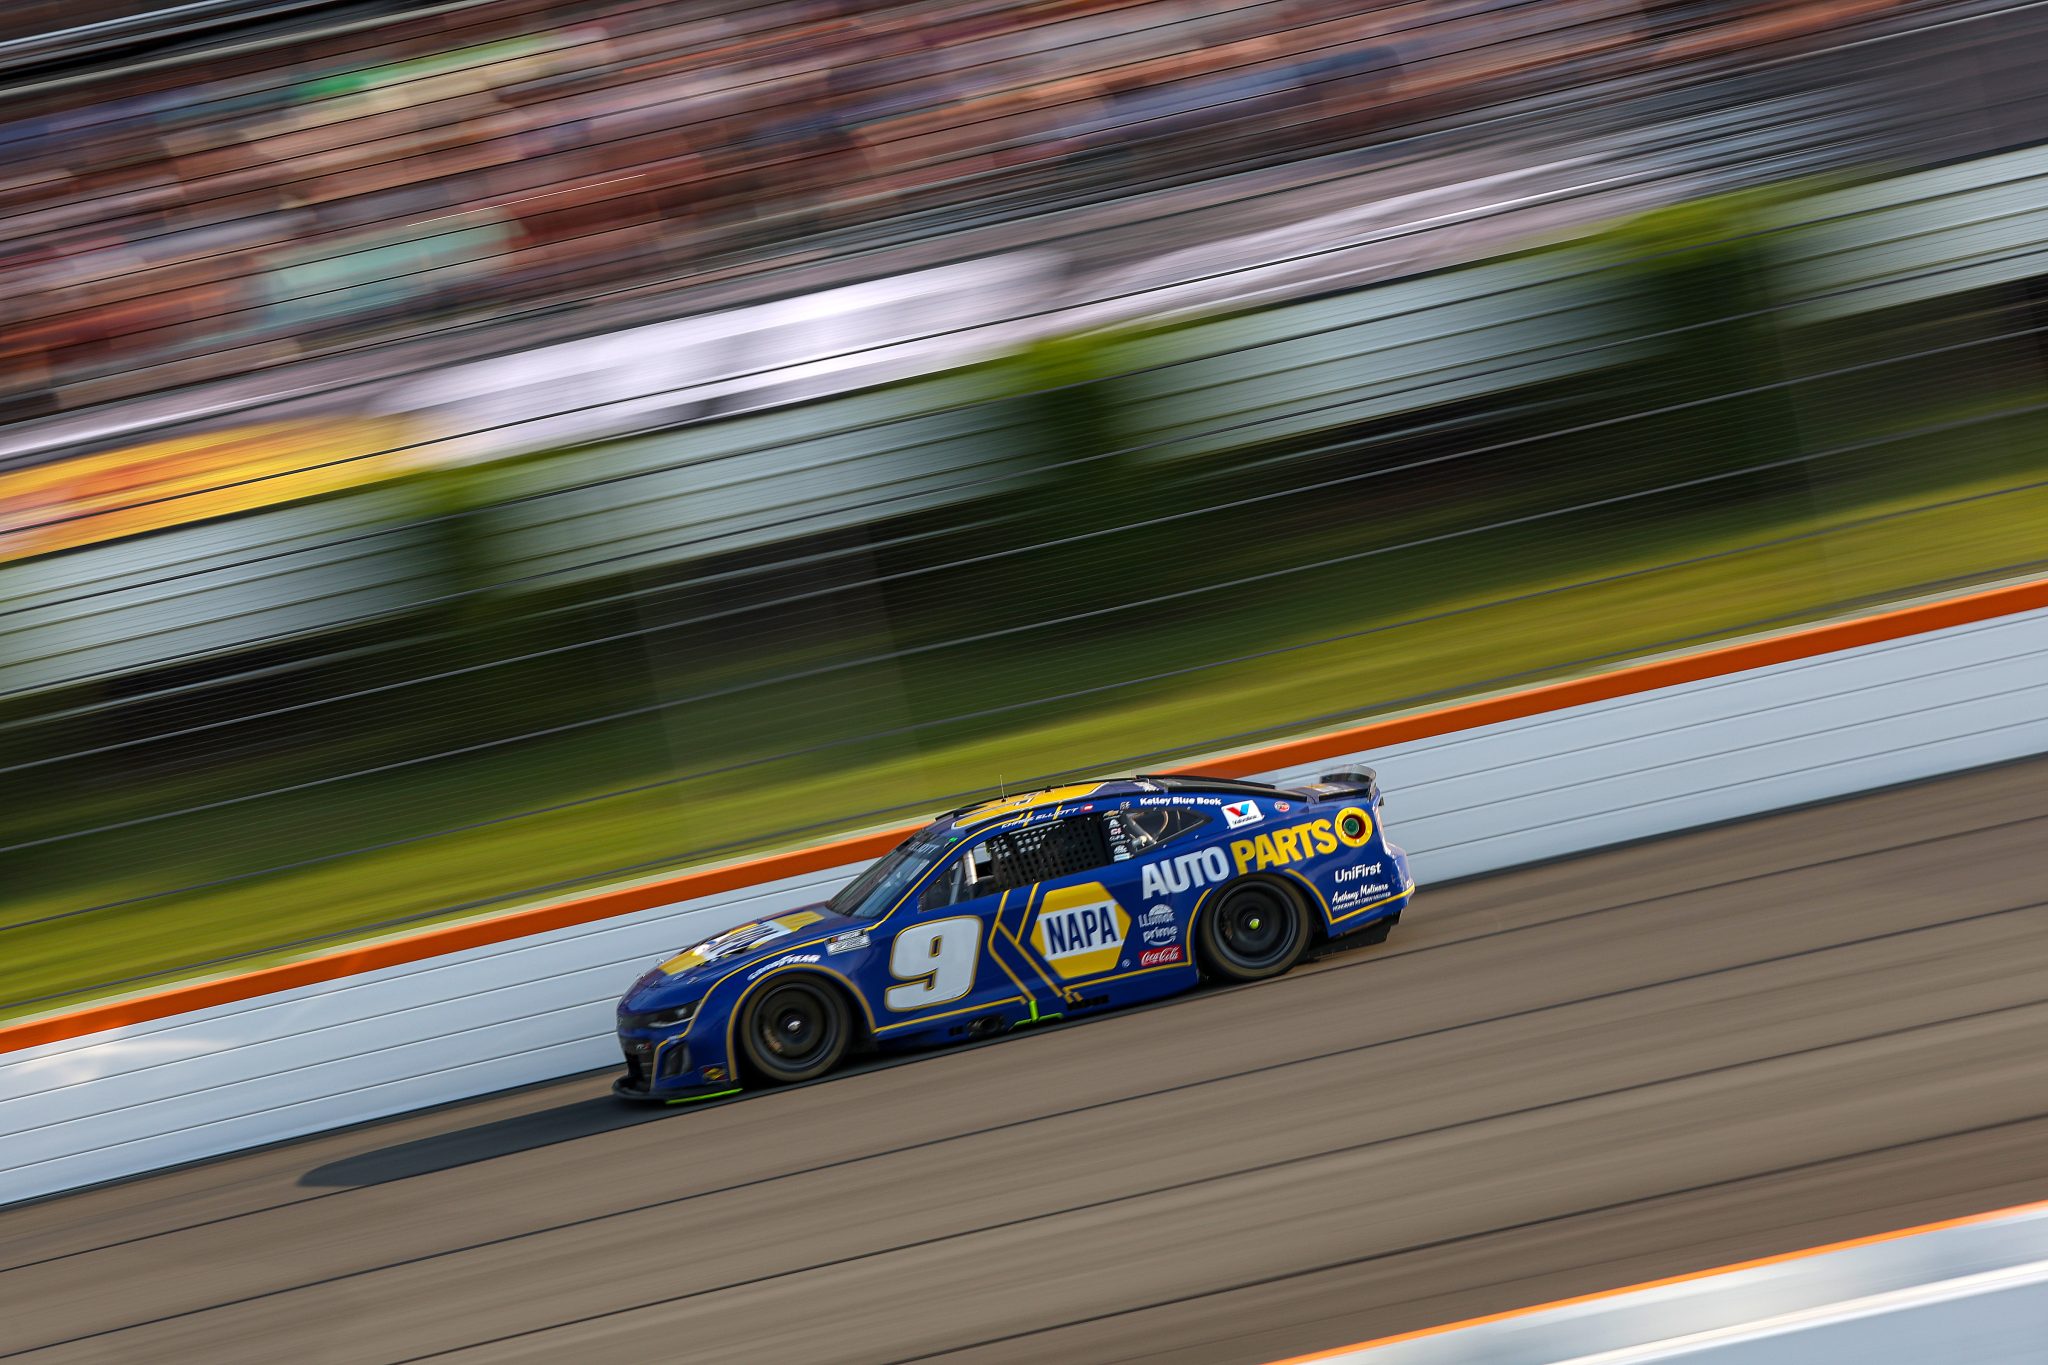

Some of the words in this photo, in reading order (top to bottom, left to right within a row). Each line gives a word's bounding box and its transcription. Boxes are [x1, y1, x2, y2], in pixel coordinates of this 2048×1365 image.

[1140, 797, 1171, 806] Kelley
[1172, 796, 1195, 805] Blue
[1196, 797, 1222, 806] Book
[1142, 845, 1230, 900] AUTO
[1231, 818, 1339, 875] PARTS
[1335, 861, 1382, 884] UniFirst
[1045, 906, 1117, 955] NAPA
[1143, 925, 1178, 943] prime
[886, 916, 982, 1011] 9
